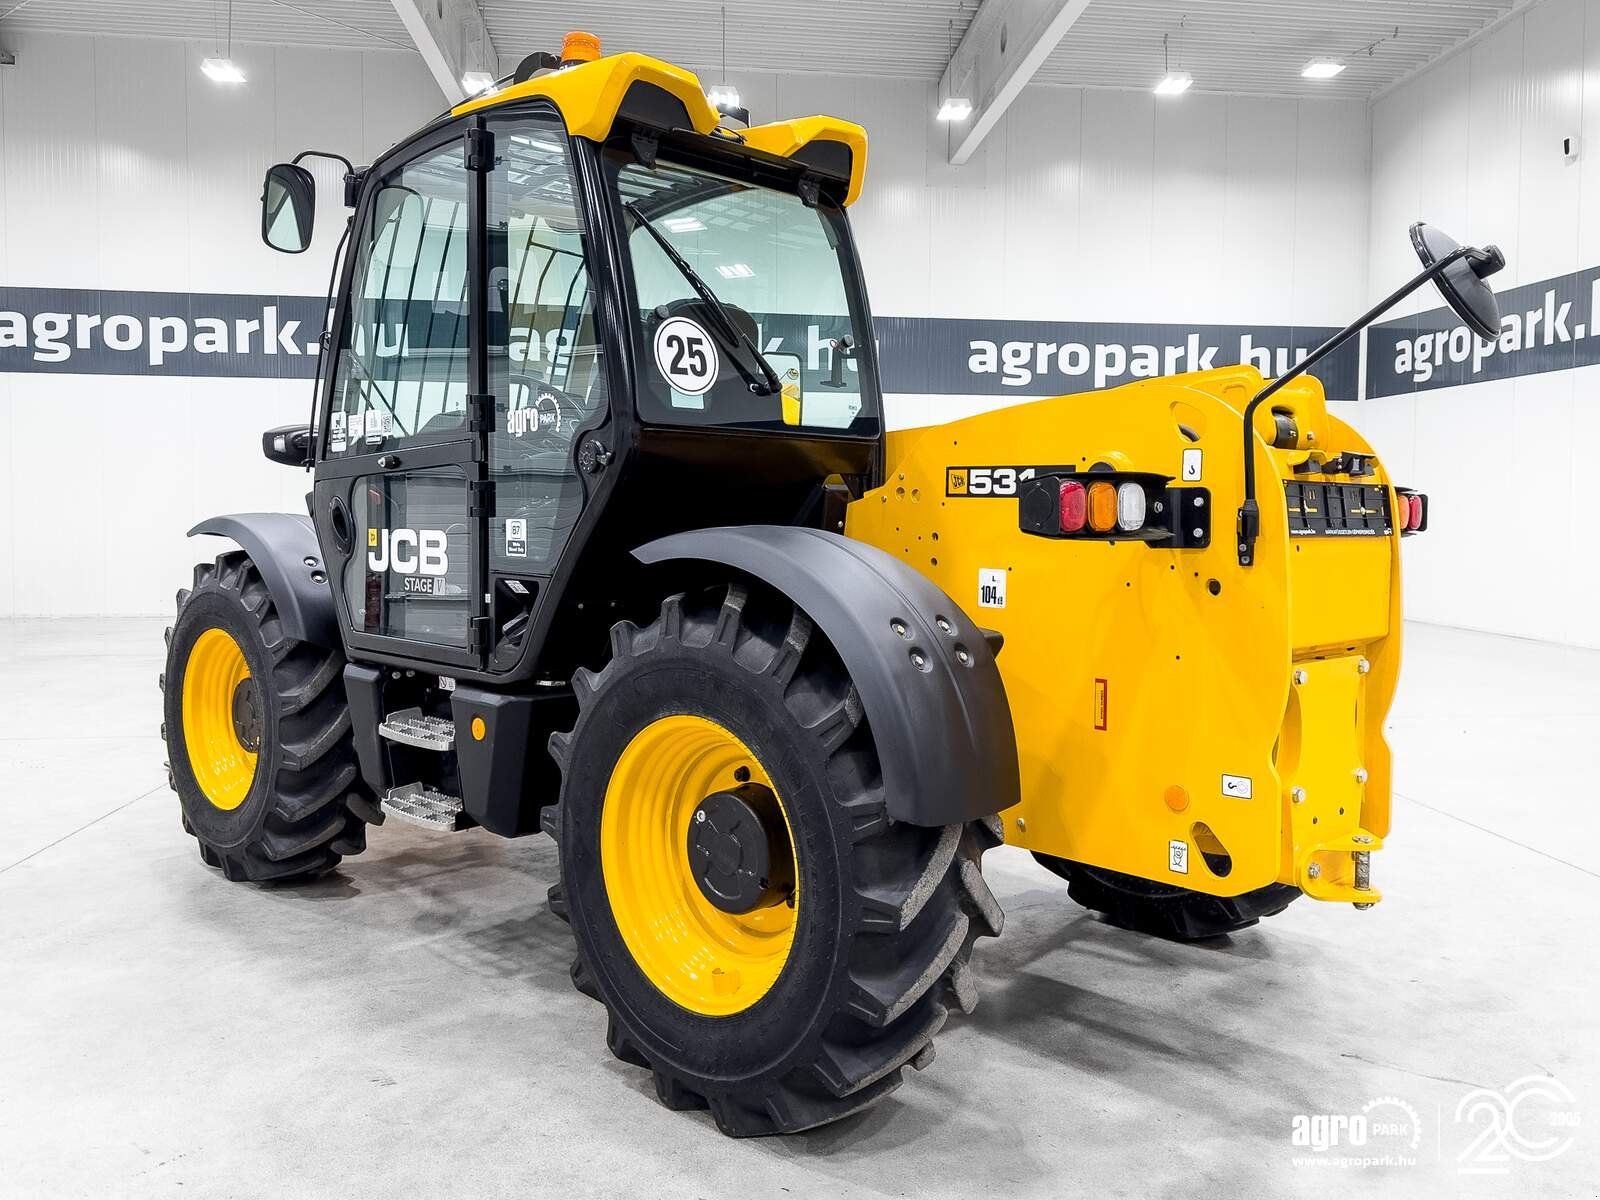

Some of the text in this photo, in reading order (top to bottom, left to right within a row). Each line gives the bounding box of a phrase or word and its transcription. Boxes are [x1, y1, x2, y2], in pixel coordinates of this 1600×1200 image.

[666, 334, 707, 377] 25
[968, 333, 1307, 388] agroparkhu
[507, 407, 556, 437] agro PARK
[368, 528, 449, 576] JCB
[404, 577, 433, 593] STAGE
[981, 585, 997, 605] 104
